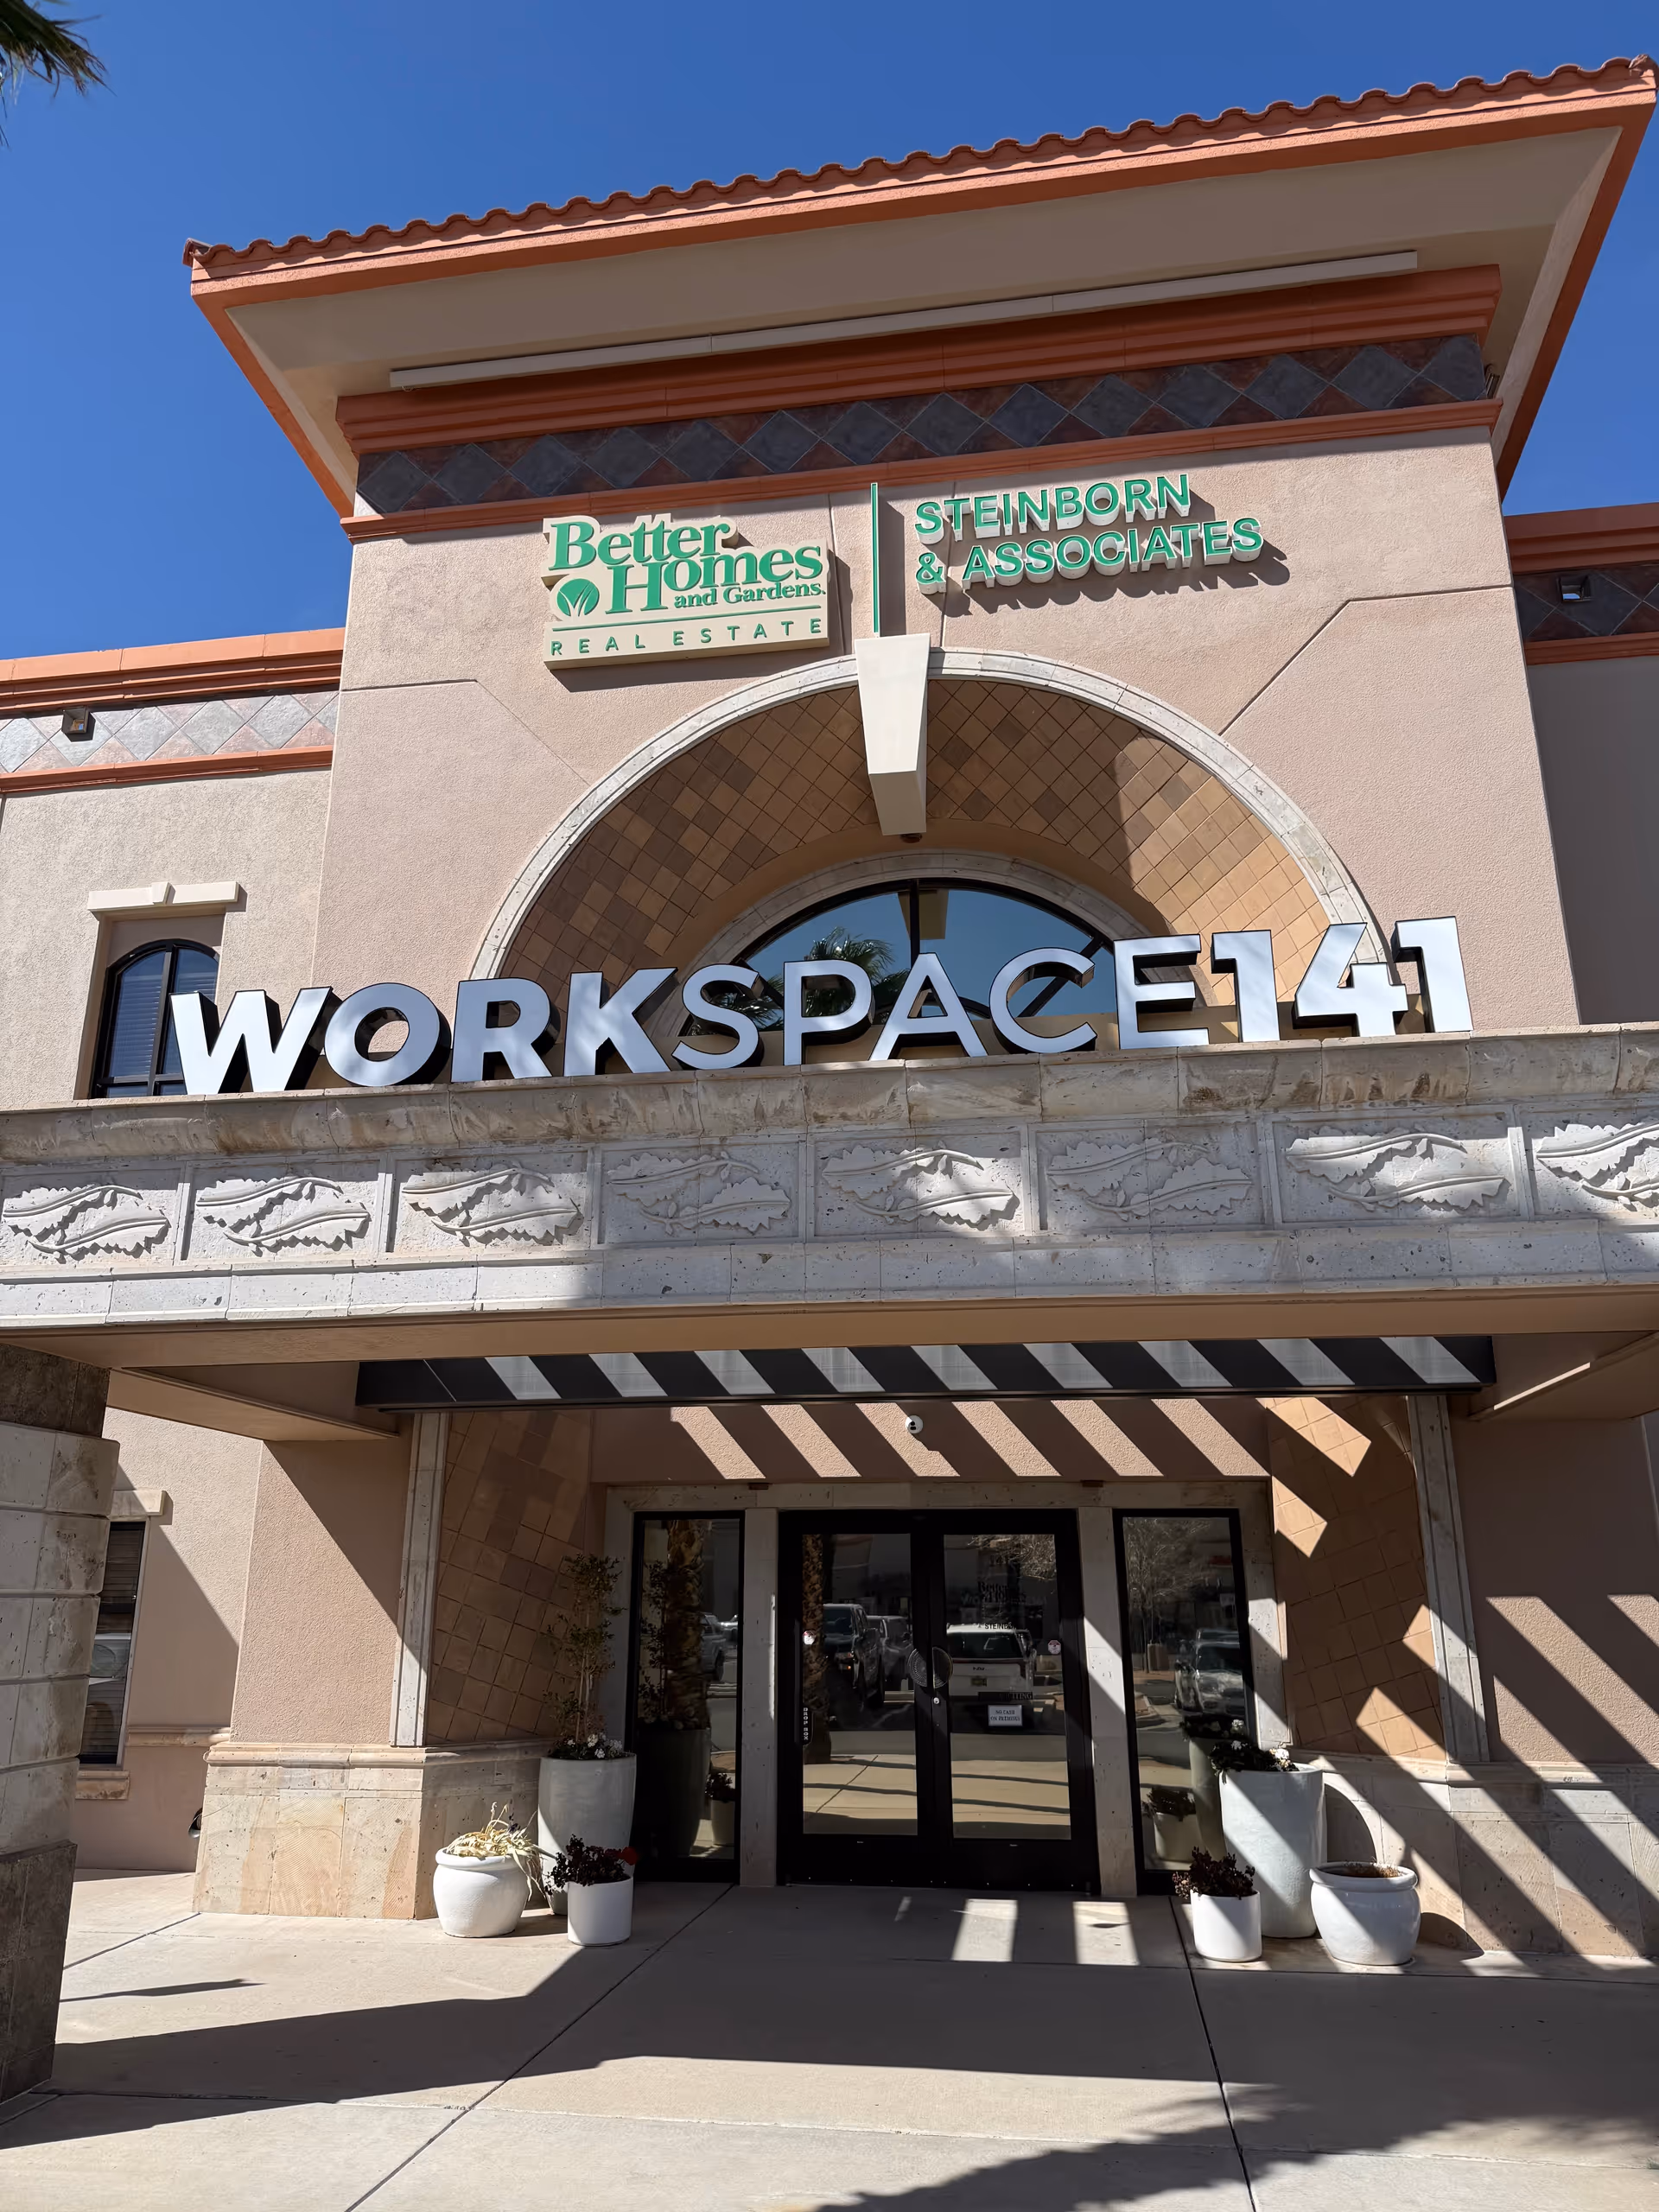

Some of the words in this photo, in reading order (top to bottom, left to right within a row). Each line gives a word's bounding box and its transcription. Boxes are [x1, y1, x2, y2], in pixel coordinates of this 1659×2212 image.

[914, 474, 1191, 537] STEINBORN
[548, 519, 731, 571] Better
[916, 551, 946, 588] &
[962, 518, 1264, 584] ASSOCIATES
[605, 545, 823, 614] Homes
[674, 588, 718, 608] and
[550, 633, 646, 656] REAL
[672, 618, 822, 646] ESTATE
